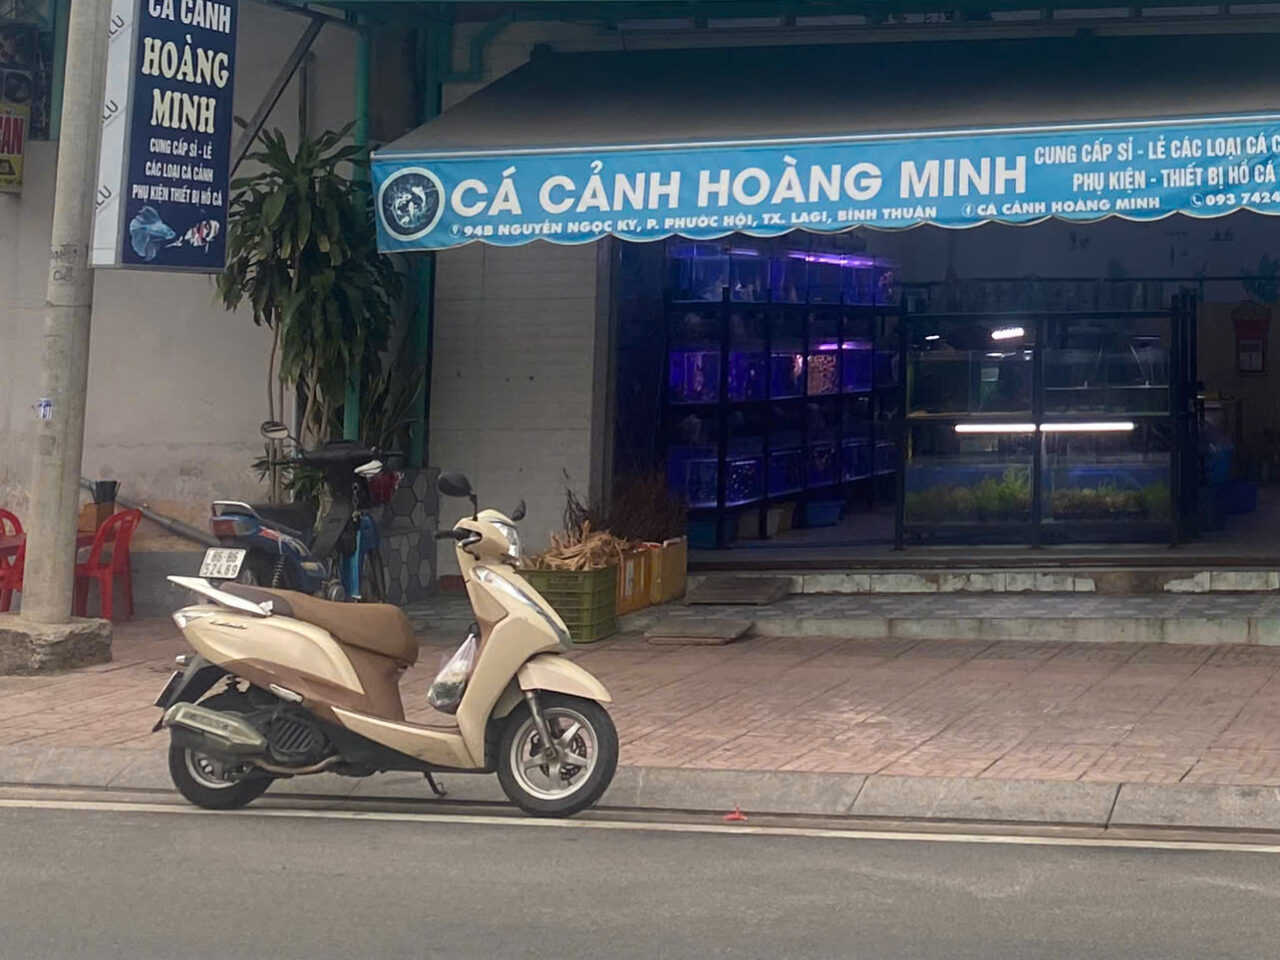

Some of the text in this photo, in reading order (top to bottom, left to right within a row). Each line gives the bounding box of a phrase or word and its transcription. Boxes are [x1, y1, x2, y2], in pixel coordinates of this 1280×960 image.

[141, 34, 229, 88] HOÀNG
[150, 88, 216, 134] MINH
[150, 138, 171, 154] CUNG
[1034, 145, 1077, 164] CUNG
[1081, 137, 1113, 162] CẤP
[1148, 135, 1166, 159] LẺ
[1171, 136, 1202, 158] CÁC
[1207, 137, 1240, 159] LOẠI
[1246, 132, 1267, 154] CÁ
[146, 159, 161, 176] CÁC
[163, 163, 180, 181] LOẠI
[1073, 159, 1275, 195] PHỤ KIỆN THIẾT BỊ HỒ CÁ
[132, 184, 149, 202] PHỤ
[451, 156, 1026, 217] CÁ CẢNH HOÀNG MINH
[1206, 193, 1235, 206] 093
[1241, 191, 1280, 204] 7424
[464, 225, 493, 237] 94B
[567, 219, 612, 235] NGỌC
[646, 218, 659, 229] P.
[664, 215, 718, 228] PHƯỚC
[723, 212, 758, 229] HỘI,
[762, 213, 785, 224] TX.
[791, 211, 832, 224] LAGI,
[882, 205, 937, 221] THUẬN
[977, 202, 997, 216] CÁ
[1051, 198, 1110, 212] HOÀNG
[1115, 196, 1159, 210] MINH
